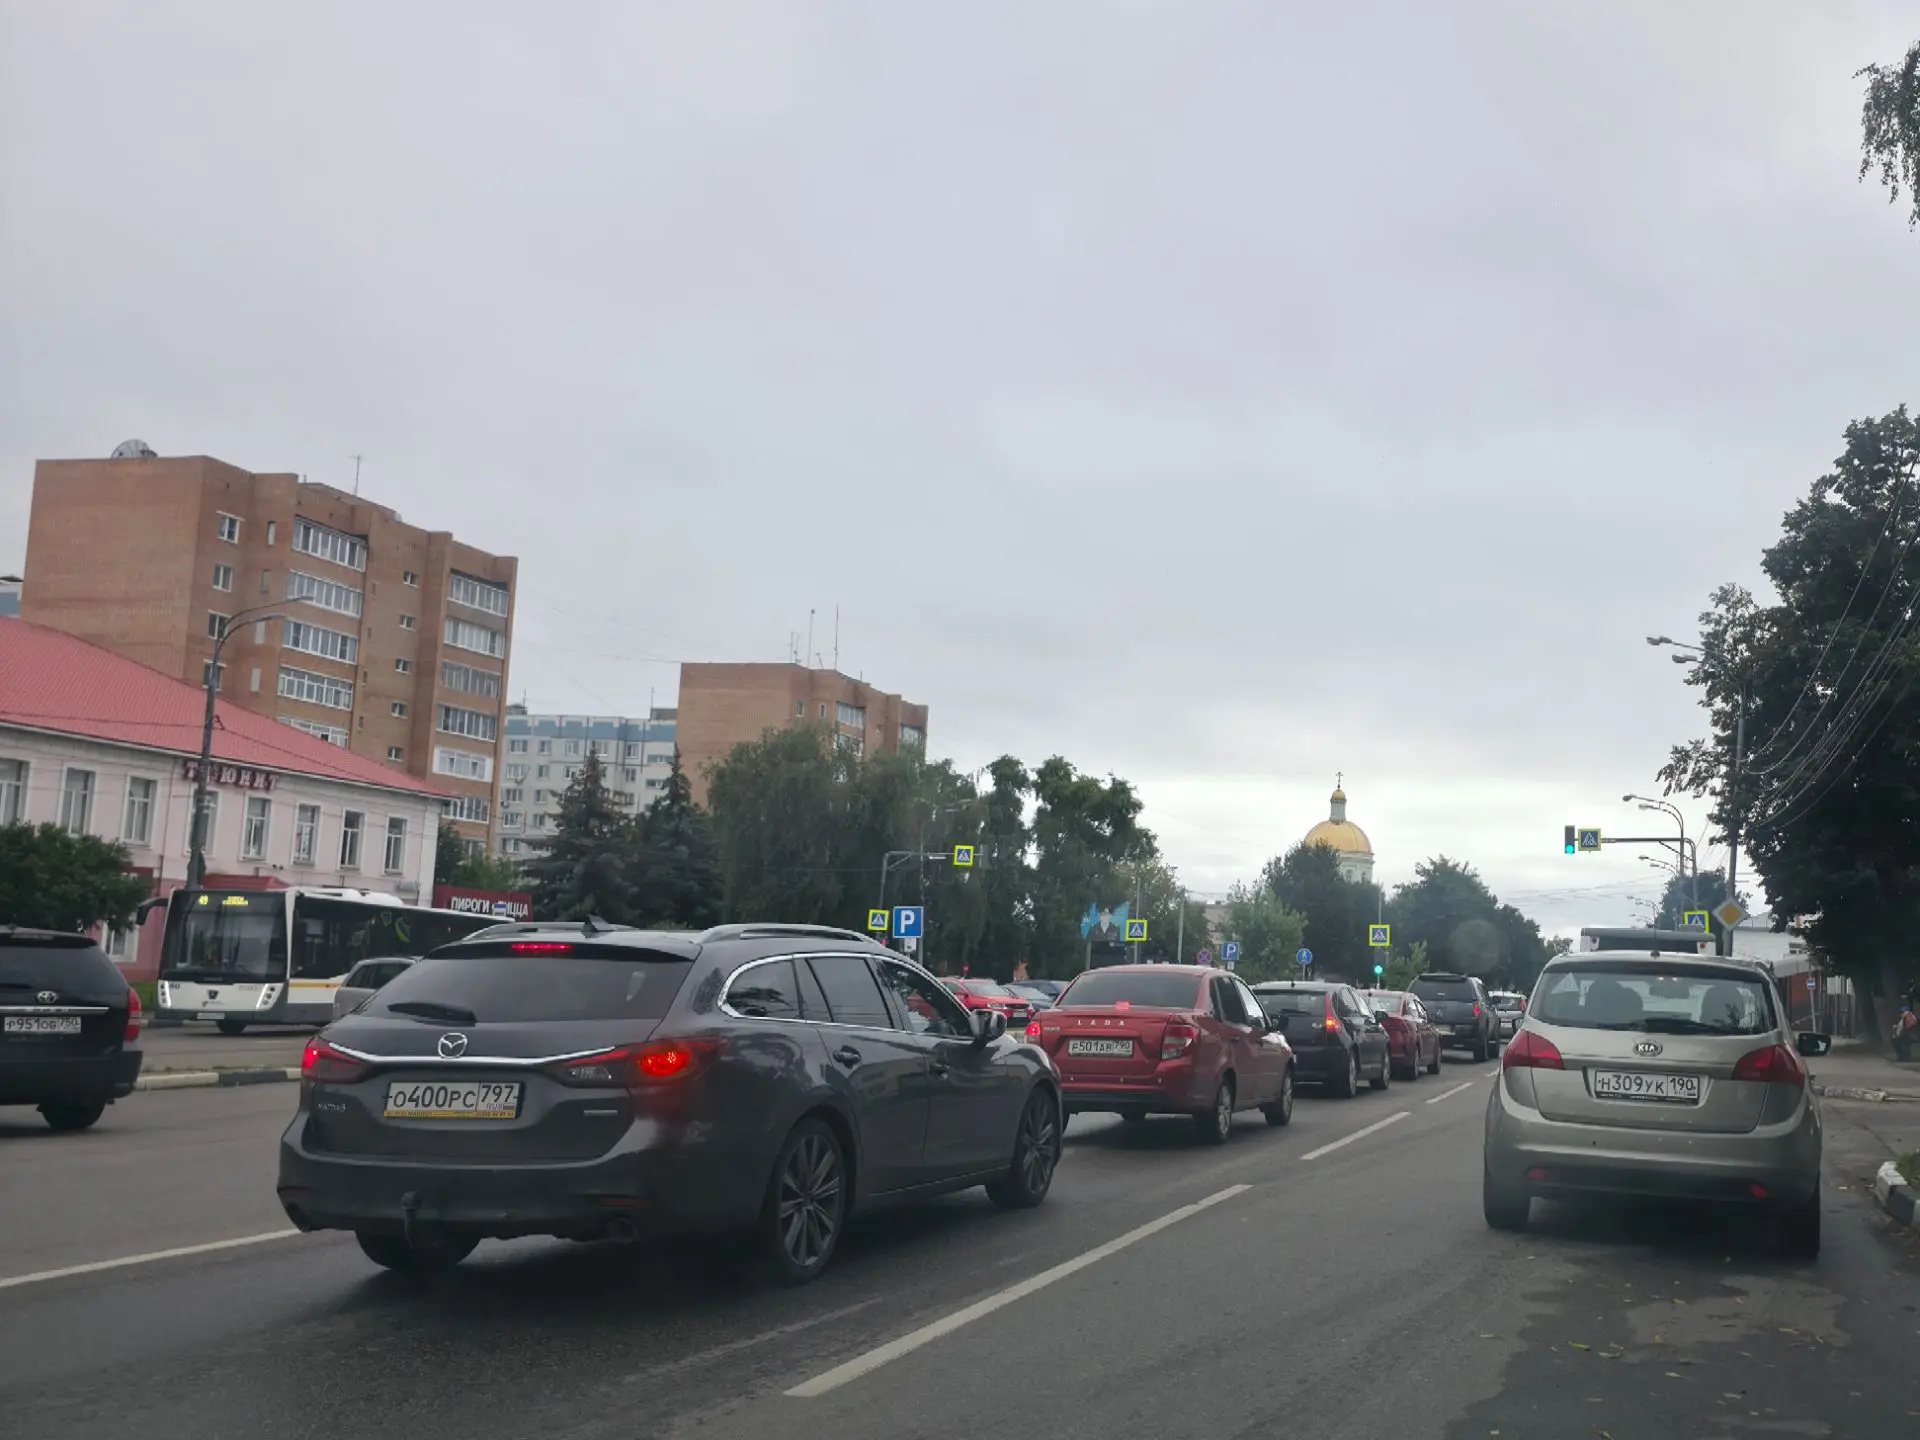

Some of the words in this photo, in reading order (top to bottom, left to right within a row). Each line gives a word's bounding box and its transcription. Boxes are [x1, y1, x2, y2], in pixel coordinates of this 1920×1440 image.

[451, 896, 490, 913] ПИРОГИ
[497, 900, 529, 917] ИЦЦА
[900, 910, 915, 934] P
[1227, 943, 1237, 960] P
[1638, 1043, 1656, 1052] KIA
[1601, 1074, 1665, 1094] Н309УК
[1670, 1077, 1694, 1091] 190
[393, 1085, 476, 1108] О400РС
[481, 1084, 514, 1103] 797
